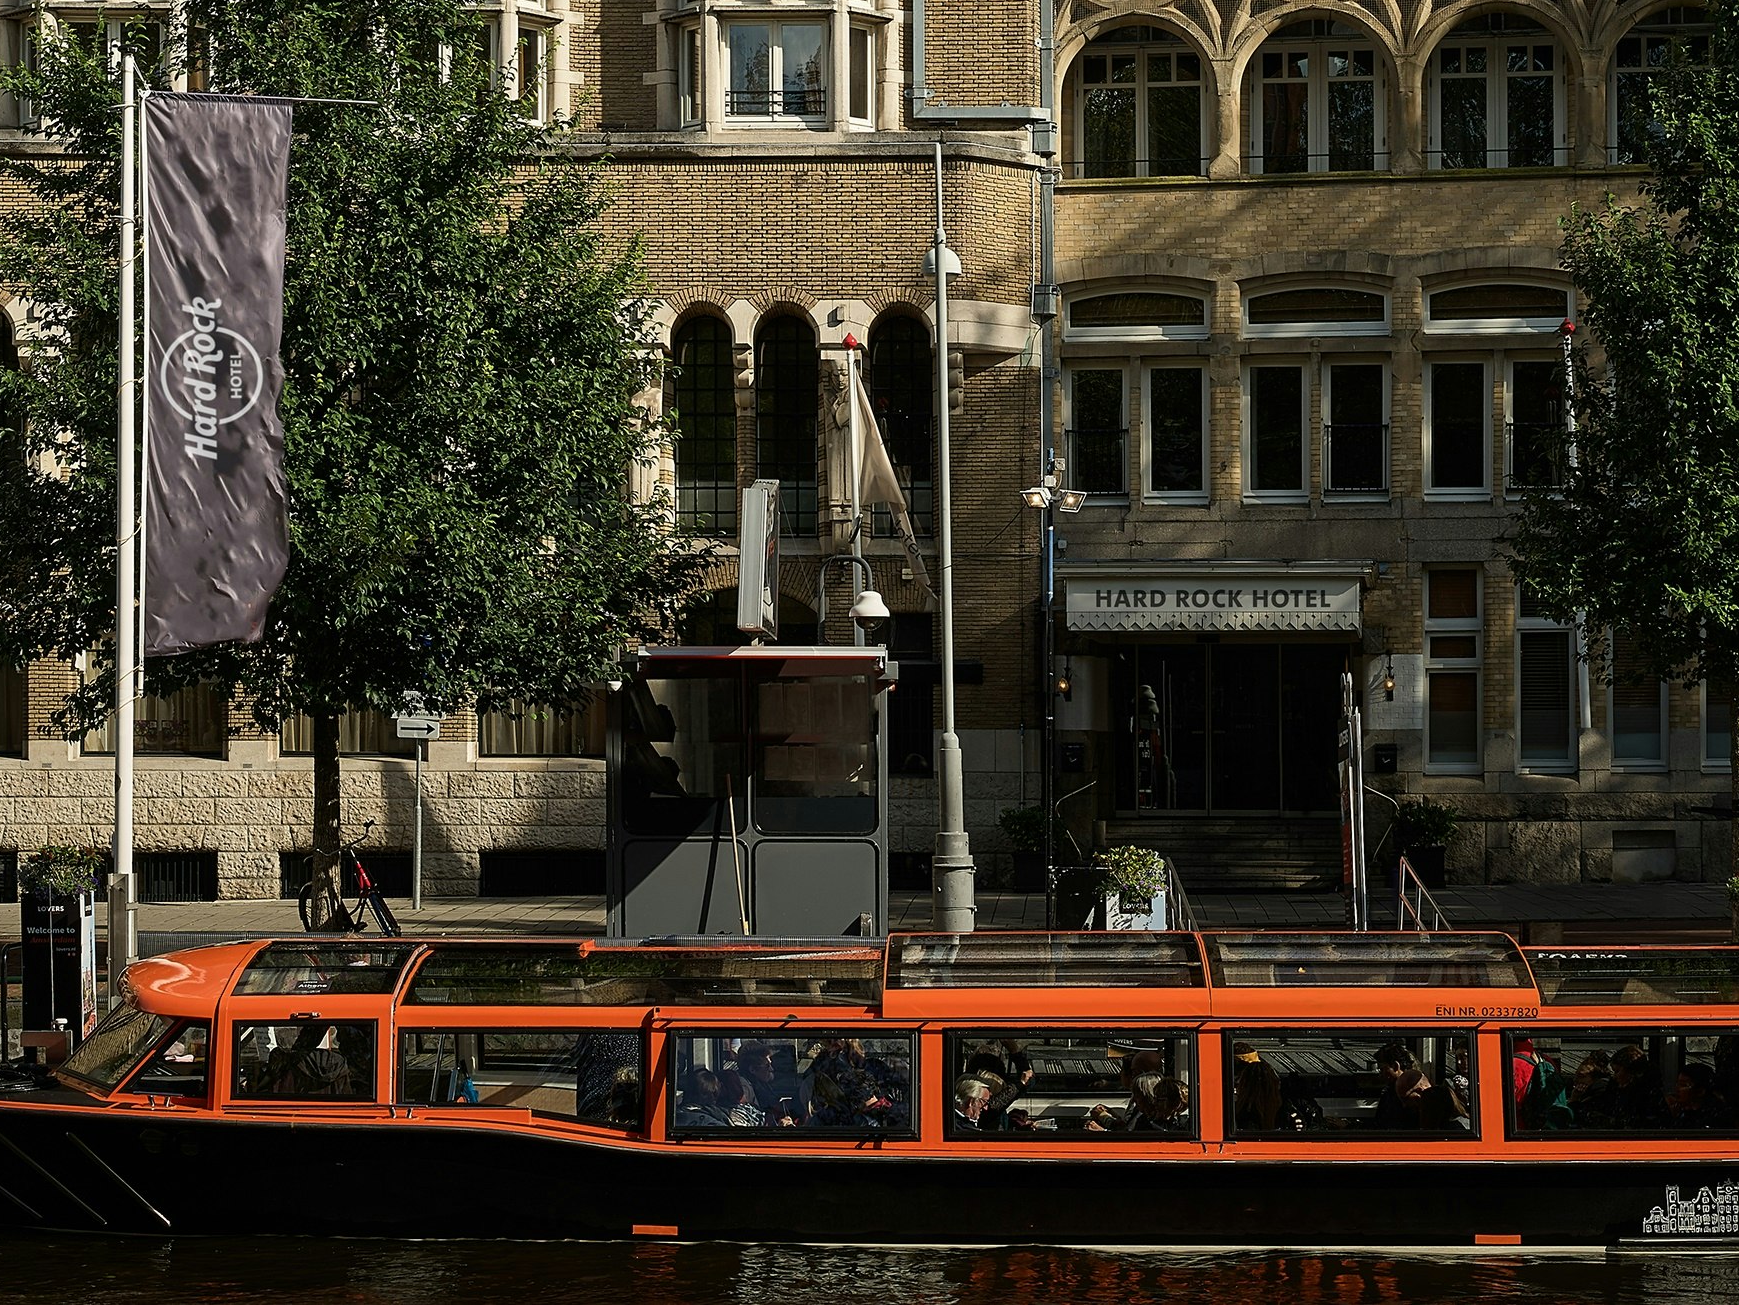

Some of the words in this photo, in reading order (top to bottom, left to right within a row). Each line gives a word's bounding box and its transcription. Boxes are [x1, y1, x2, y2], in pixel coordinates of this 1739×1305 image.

[182, 296, 223, 374] Rock
[230, 352, 243, 399] HOTEL
[183, 377, 218, 460] Hard
[1095, 589, 1167, 608] HARD
[1175, 589, 1243, 608] ROCK
[1252, 589, 1331, 608] HOTEL
[1435, 1007, 1455, 1016] ENI
[1459, 1007, 1479, 1016] NR.
[1481, 1007, 1538, 1017] 02337820
